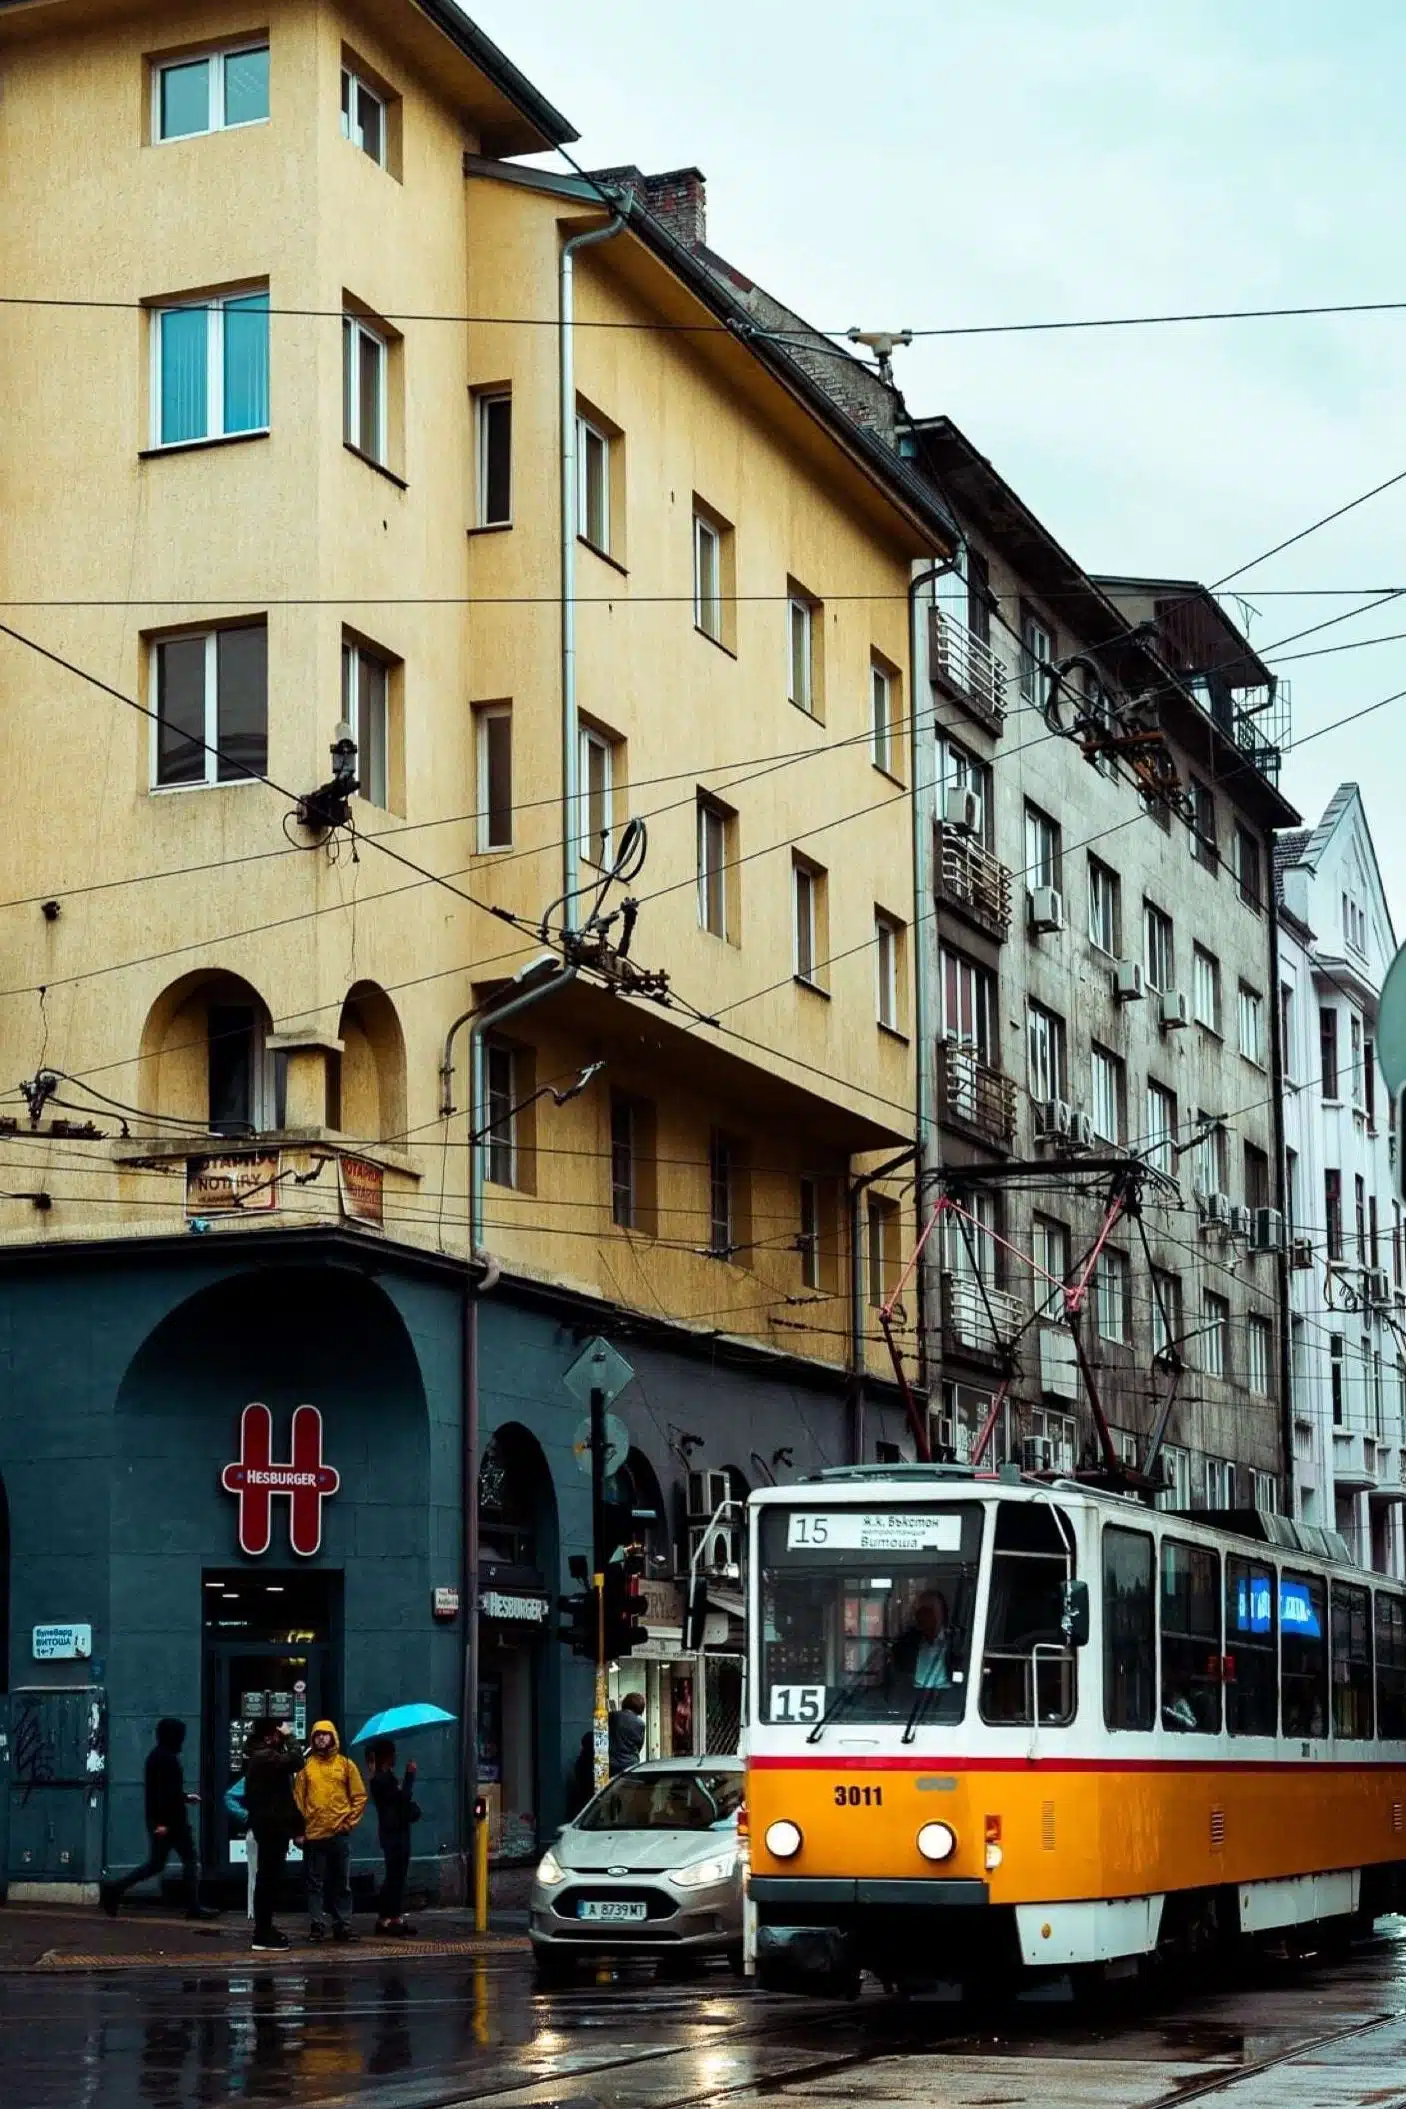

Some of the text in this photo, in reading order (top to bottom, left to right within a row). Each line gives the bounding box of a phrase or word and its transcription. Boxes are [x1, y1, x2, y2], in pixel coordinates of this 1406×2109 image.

[246, 1469, 317, 1488] HESBURGER
[795, 1518, 828, 1544] 15
[860, 1536, 918, 1548] Витоша
[488, 1591, 543, 1622] HESBURGER
[776, 1689, 819, 1721] 15
[834, 1785, 883, 1807] 3011
